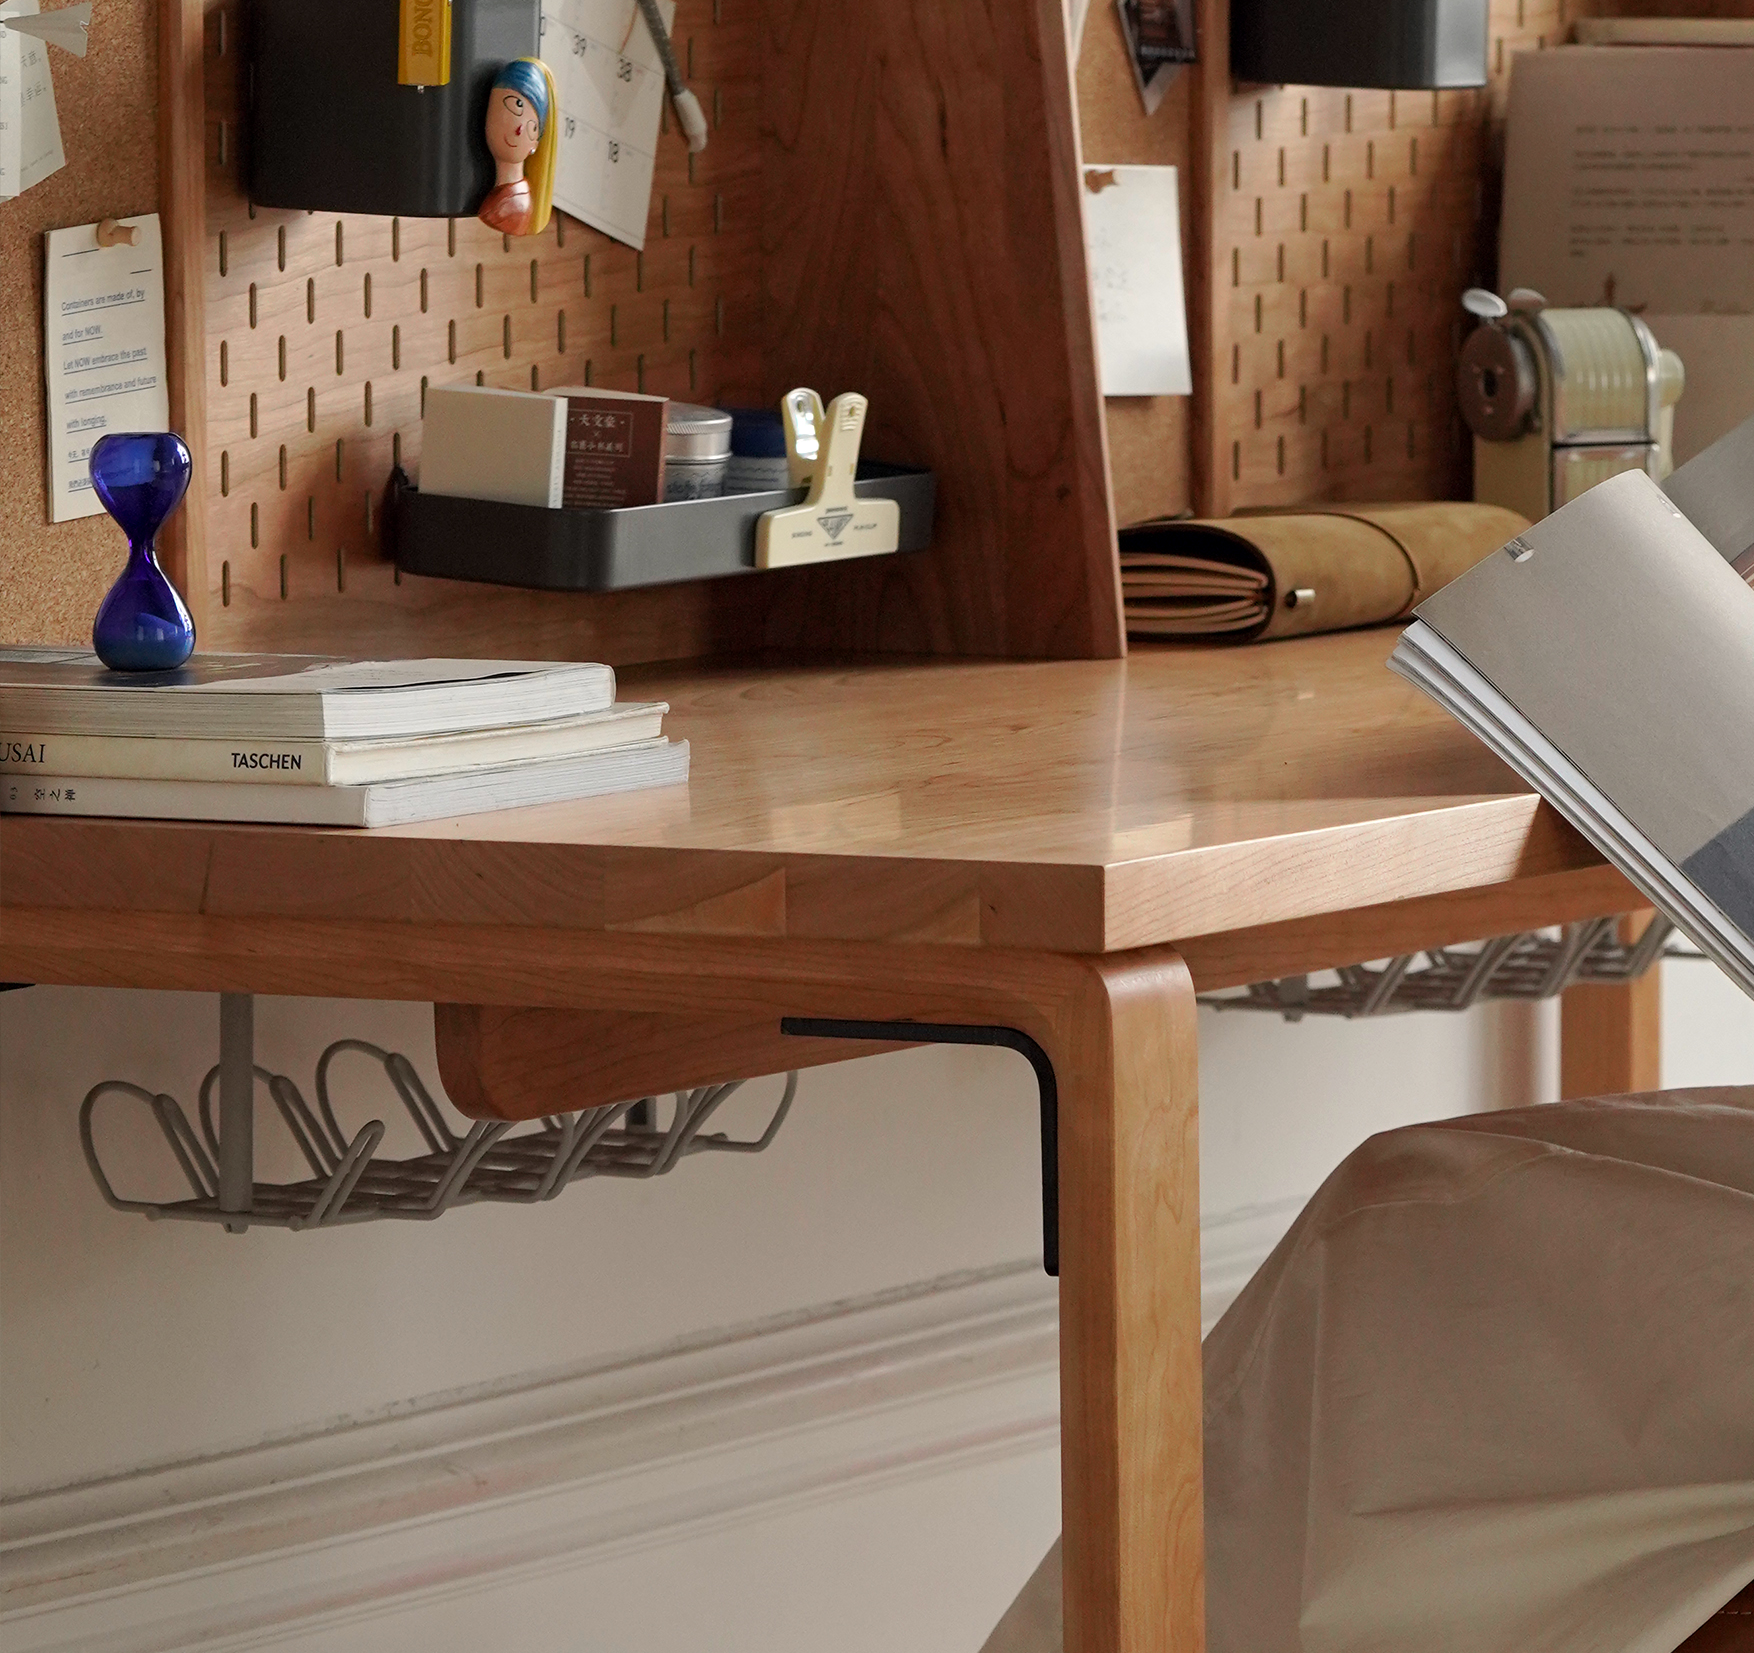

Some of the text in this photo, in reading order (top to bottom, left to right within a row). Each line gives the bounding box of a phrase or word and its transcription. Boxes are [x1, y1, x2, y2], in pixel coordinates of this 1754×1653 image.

[571, 33, 587, 58] 39
[616, 57, 633, 83] 38
[563, 116, 576, 140] 19
[608, 139, 620, 165] 18
[61, 288, 146, 312] Containers are made of, by
[62, 331, 74, 341] and
[75, 328, 84, 339] for
[63, 347, 147, 371] Let NOW embrace the past
[65, 374, 157, 400] with remembrance and future
[66, 414, 108, 430] with longing.
[0, 742, 303, 770] USAI TASCHEN
